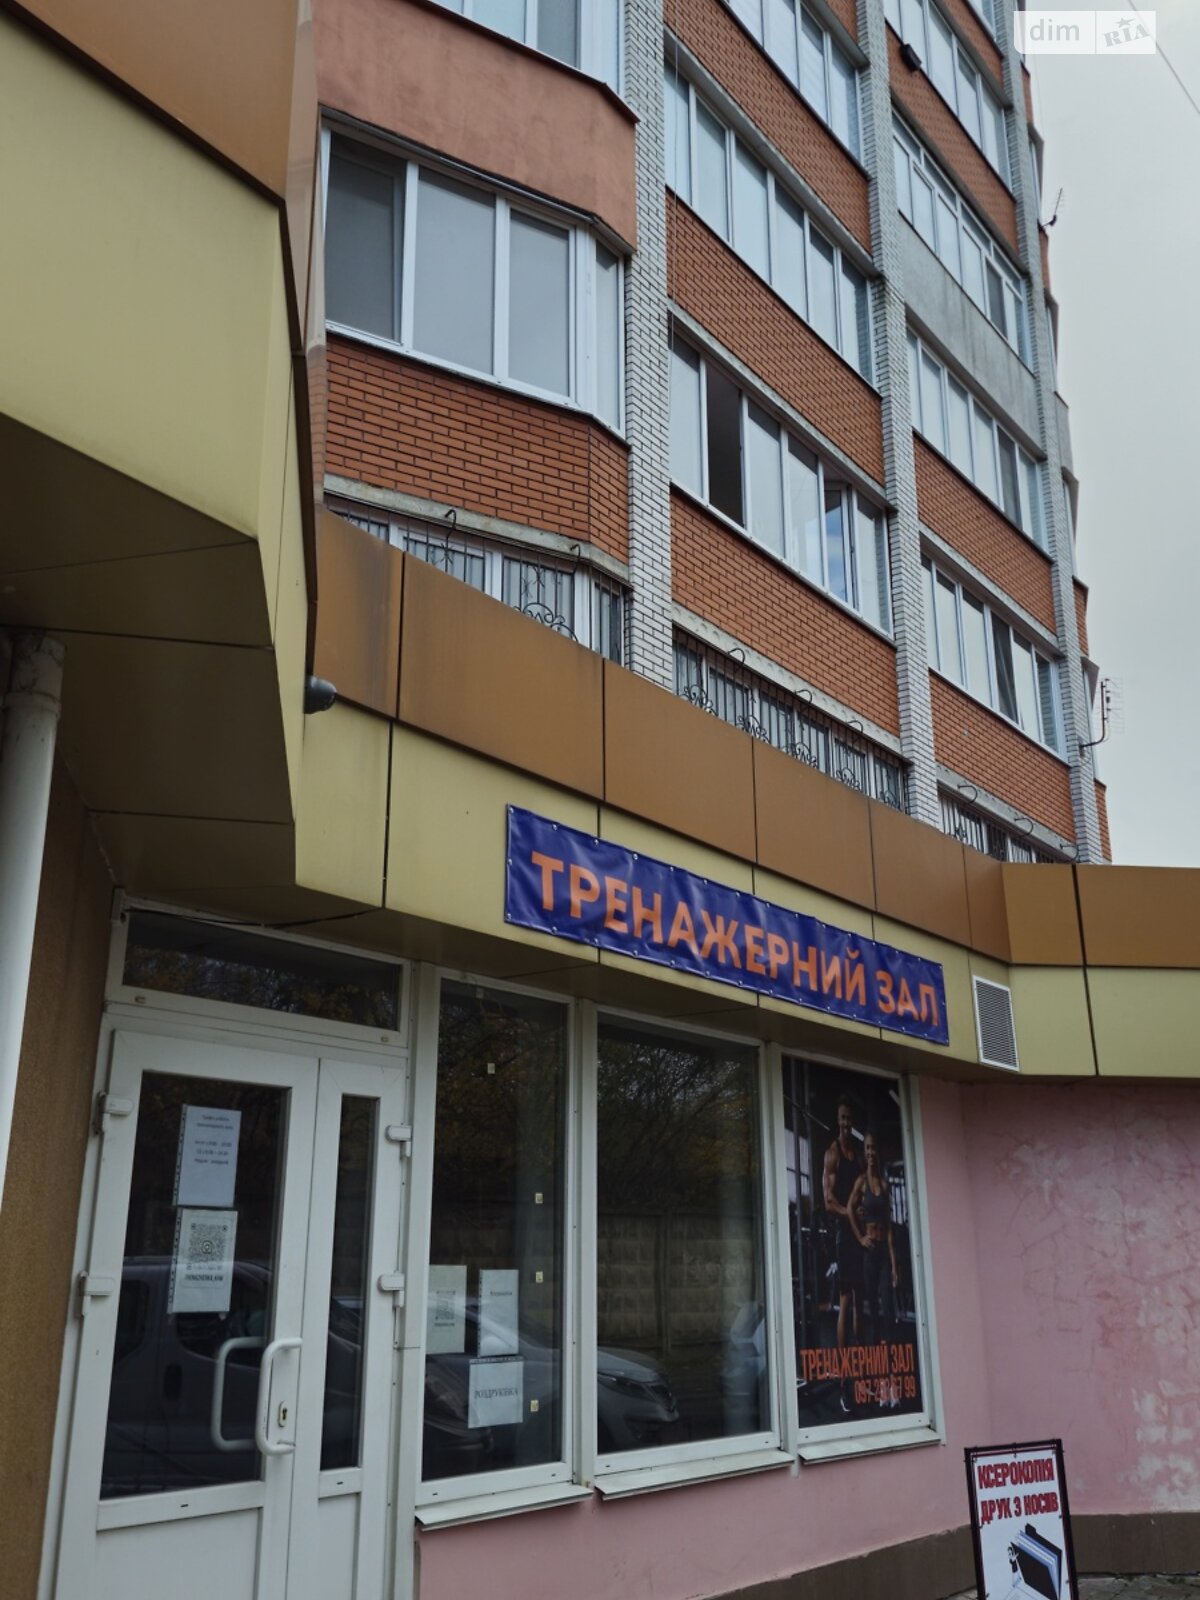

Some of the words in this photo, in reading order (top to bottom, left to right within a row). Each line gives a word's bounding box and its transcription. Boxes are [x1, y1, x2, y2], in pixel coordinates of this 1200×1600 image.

[531, 850, 866, 1007] ТРЕНАЖЕРНИЙ
[875, 969, 940, 1027] ЗАЛ
[800, 1340, 889, 1381] ТРЕНАЖЕРНИЙ
[891, 1343, 915, 1373] ЗАЛ
[904, 1375, 917, 1399] 99
[977, 1458, 1055, 1489] КСЕРОКОПІЯ
[980, 1496, 1013, 1525] ДРУК
